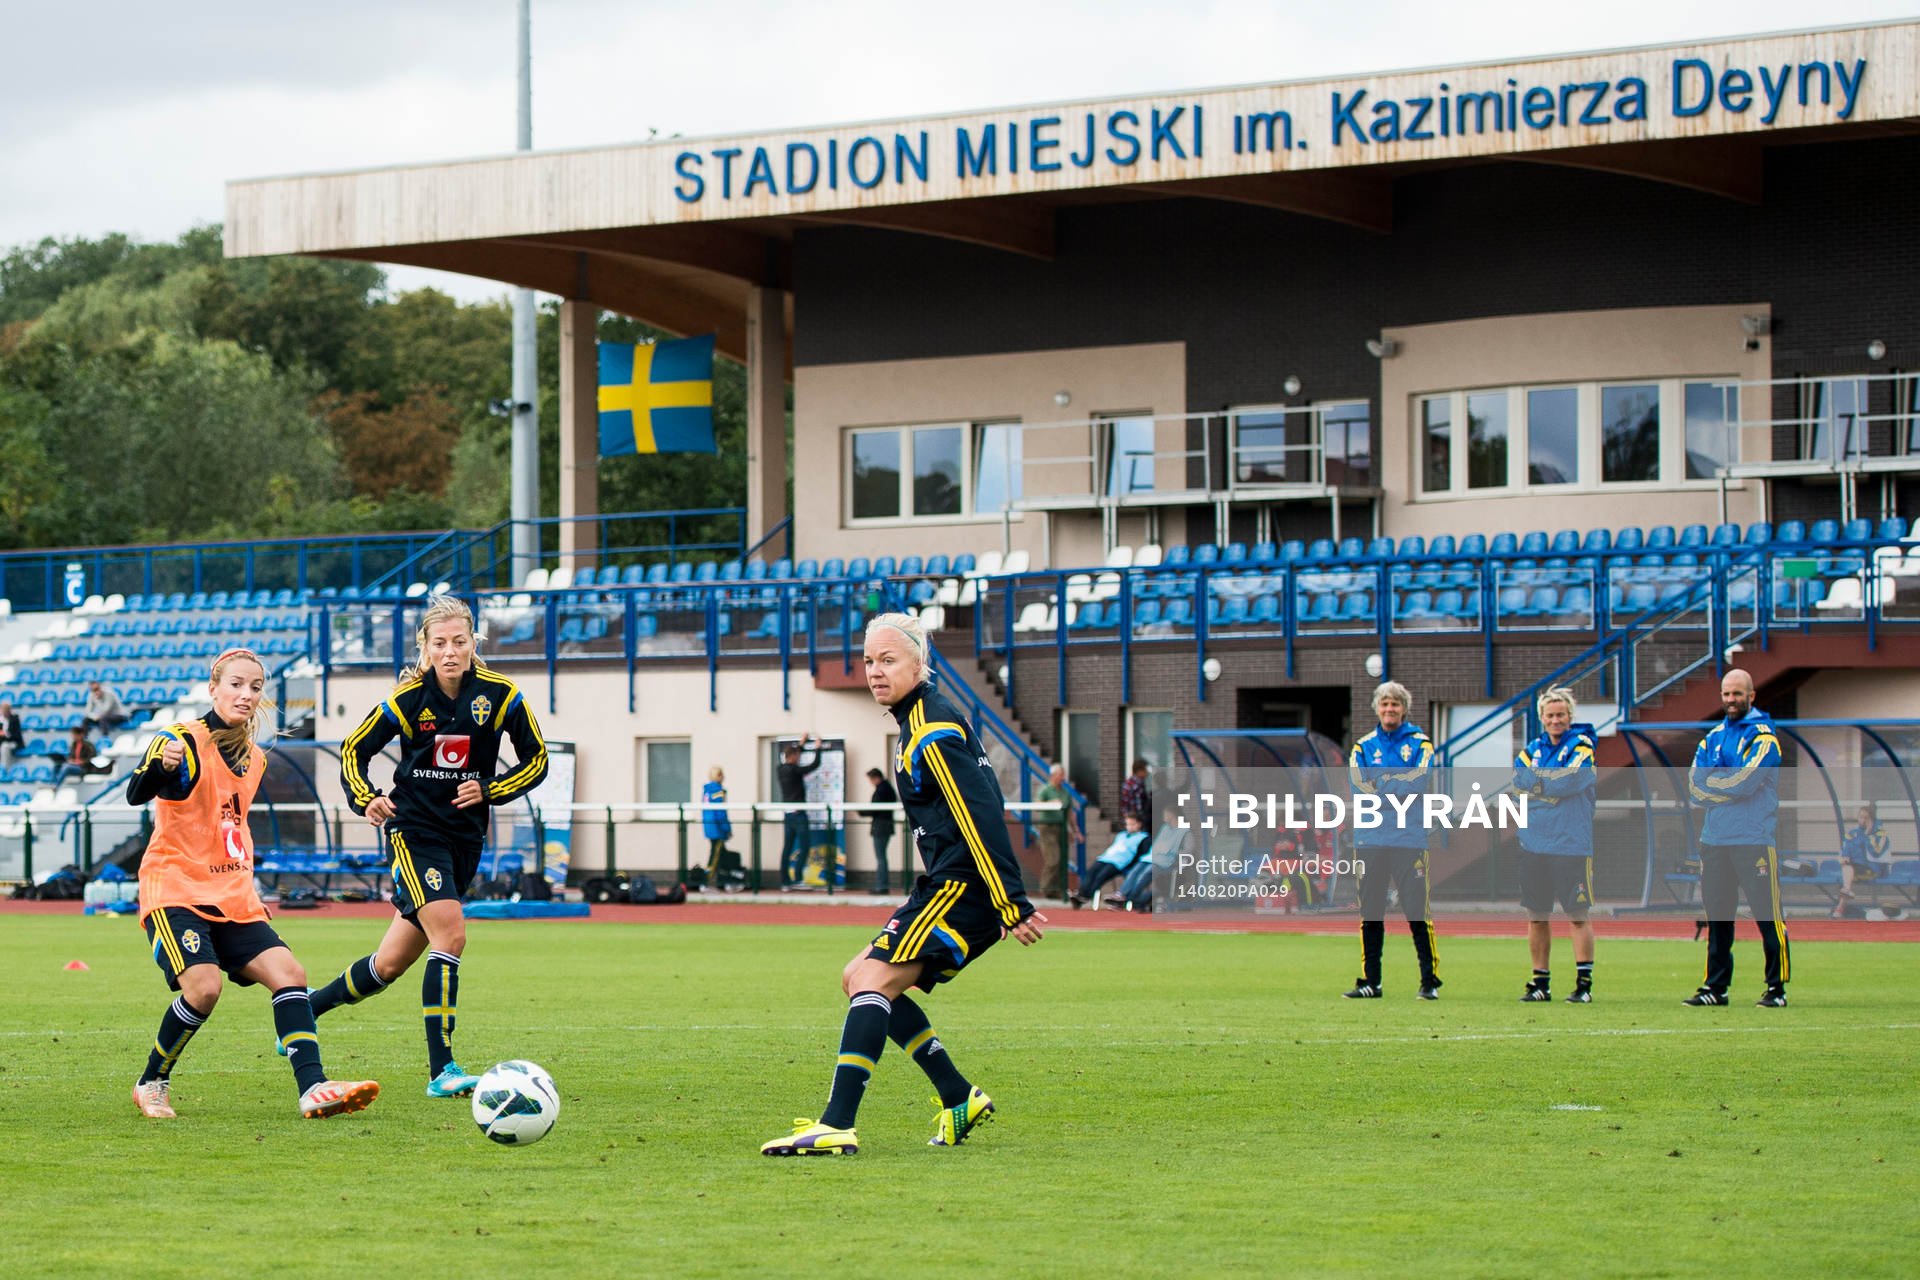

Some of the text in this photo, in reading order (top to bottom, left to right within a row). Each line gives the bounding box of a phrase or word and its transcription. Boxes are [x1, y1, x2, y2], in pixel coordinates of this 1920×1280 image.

[673, 130, 930, 204] STADION
[956, 105, 1204, 179] MIEJSKI
[1331, 76, 1648, 146] Kazimierza
[1671, 58, 1867, 124] Deyny
[413, 768, 481, 780] SVENSKA SPEL
